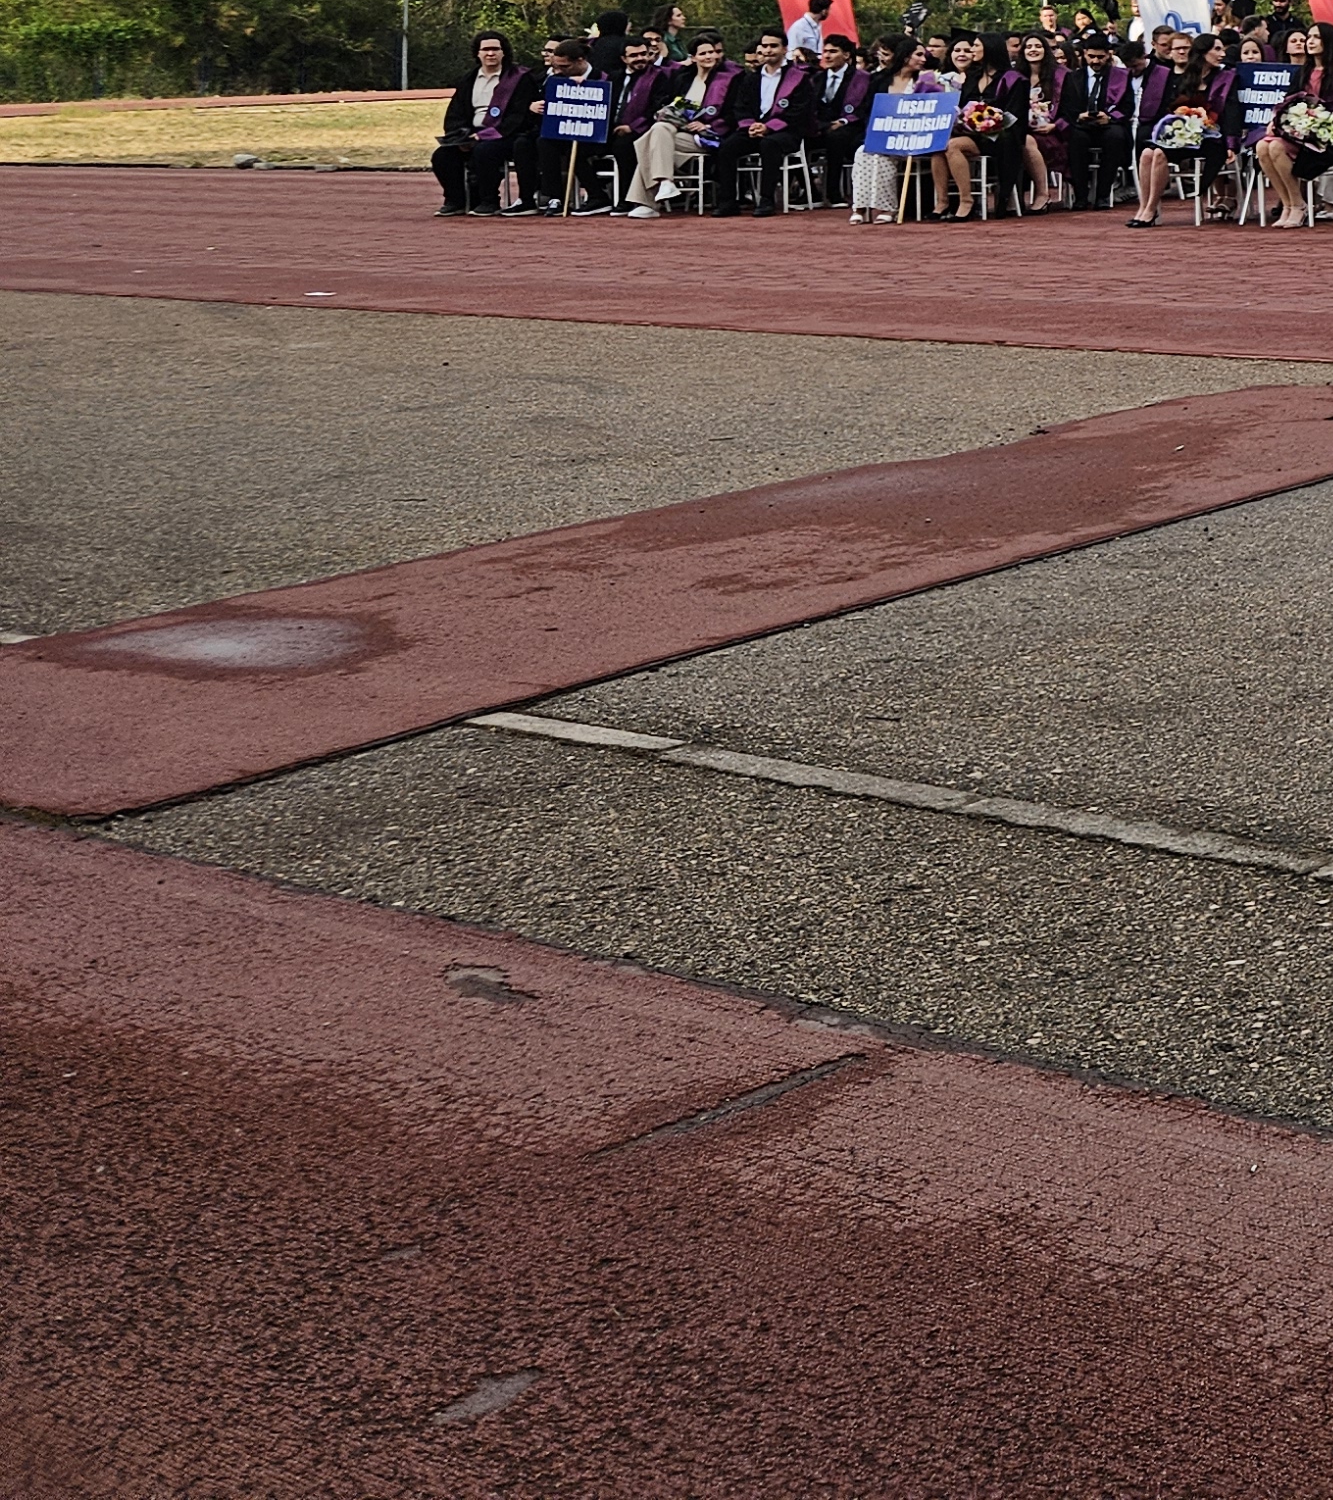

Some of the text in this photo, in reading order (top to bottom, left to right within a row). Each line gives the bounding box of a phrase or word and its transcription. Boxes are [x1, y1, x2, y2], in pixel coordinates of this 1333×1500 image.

[1253, 69, 1291, 86] TEKSTİL
[896, 98, 938, 117] İNŞAAT
[1244, 107, 1273, 124] BÖLÜ
[558, 119, 594, 137] BÖLÜMÜ
[872, 114, 952, 132] MÜHENDİSLİĞİ
[885, 133, 933, 151] BÖLÜMÜ
